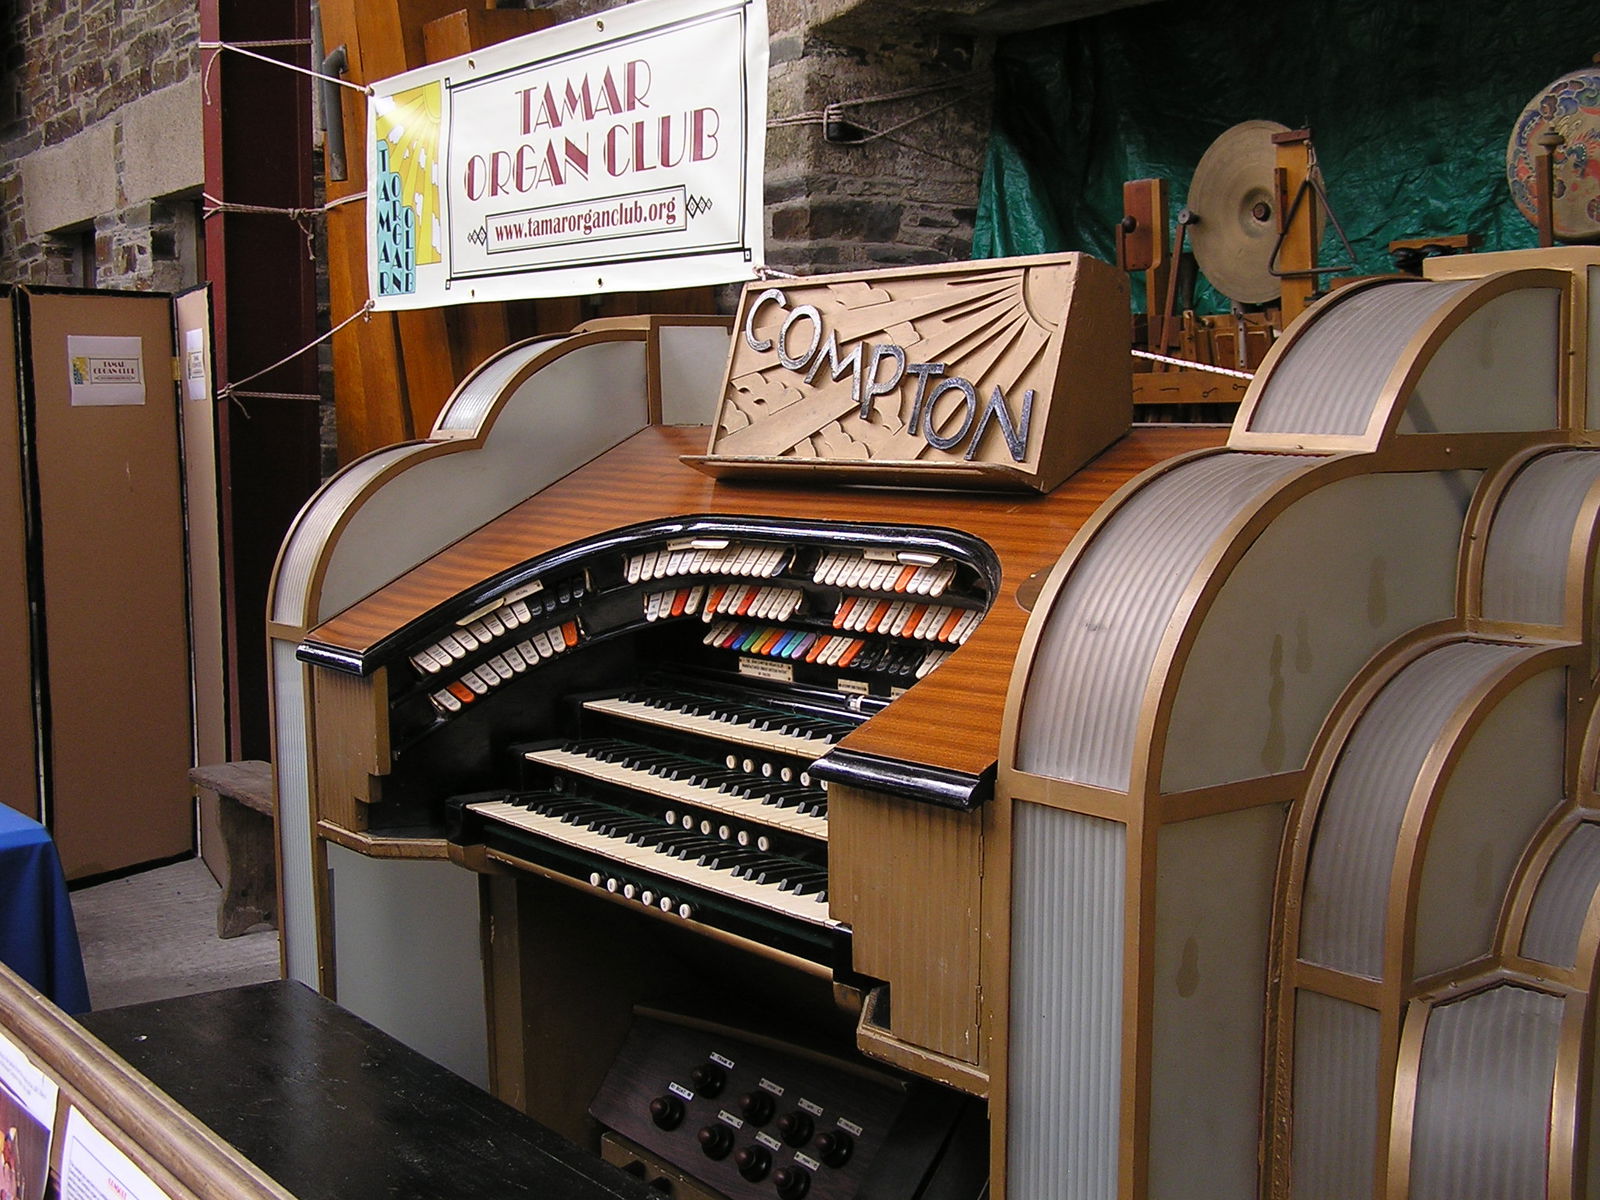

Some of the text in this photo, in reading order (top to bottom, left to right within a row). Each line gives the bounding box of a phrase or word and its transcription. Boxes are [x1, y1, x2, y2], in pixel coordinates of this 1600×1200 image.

[515, 59, 651, 135] TAMAR
[464, 107, 719, 201] ORGAN CLUB
[379, 149, 391, 294] TAMAR
[391, 174, 402, 292] ORGAN
[404, 207, 414, 292] CLUB
[495, 197, 676, 241] www.tamarorganclub.org
[745, 288, 1036, 462] COMPTON
